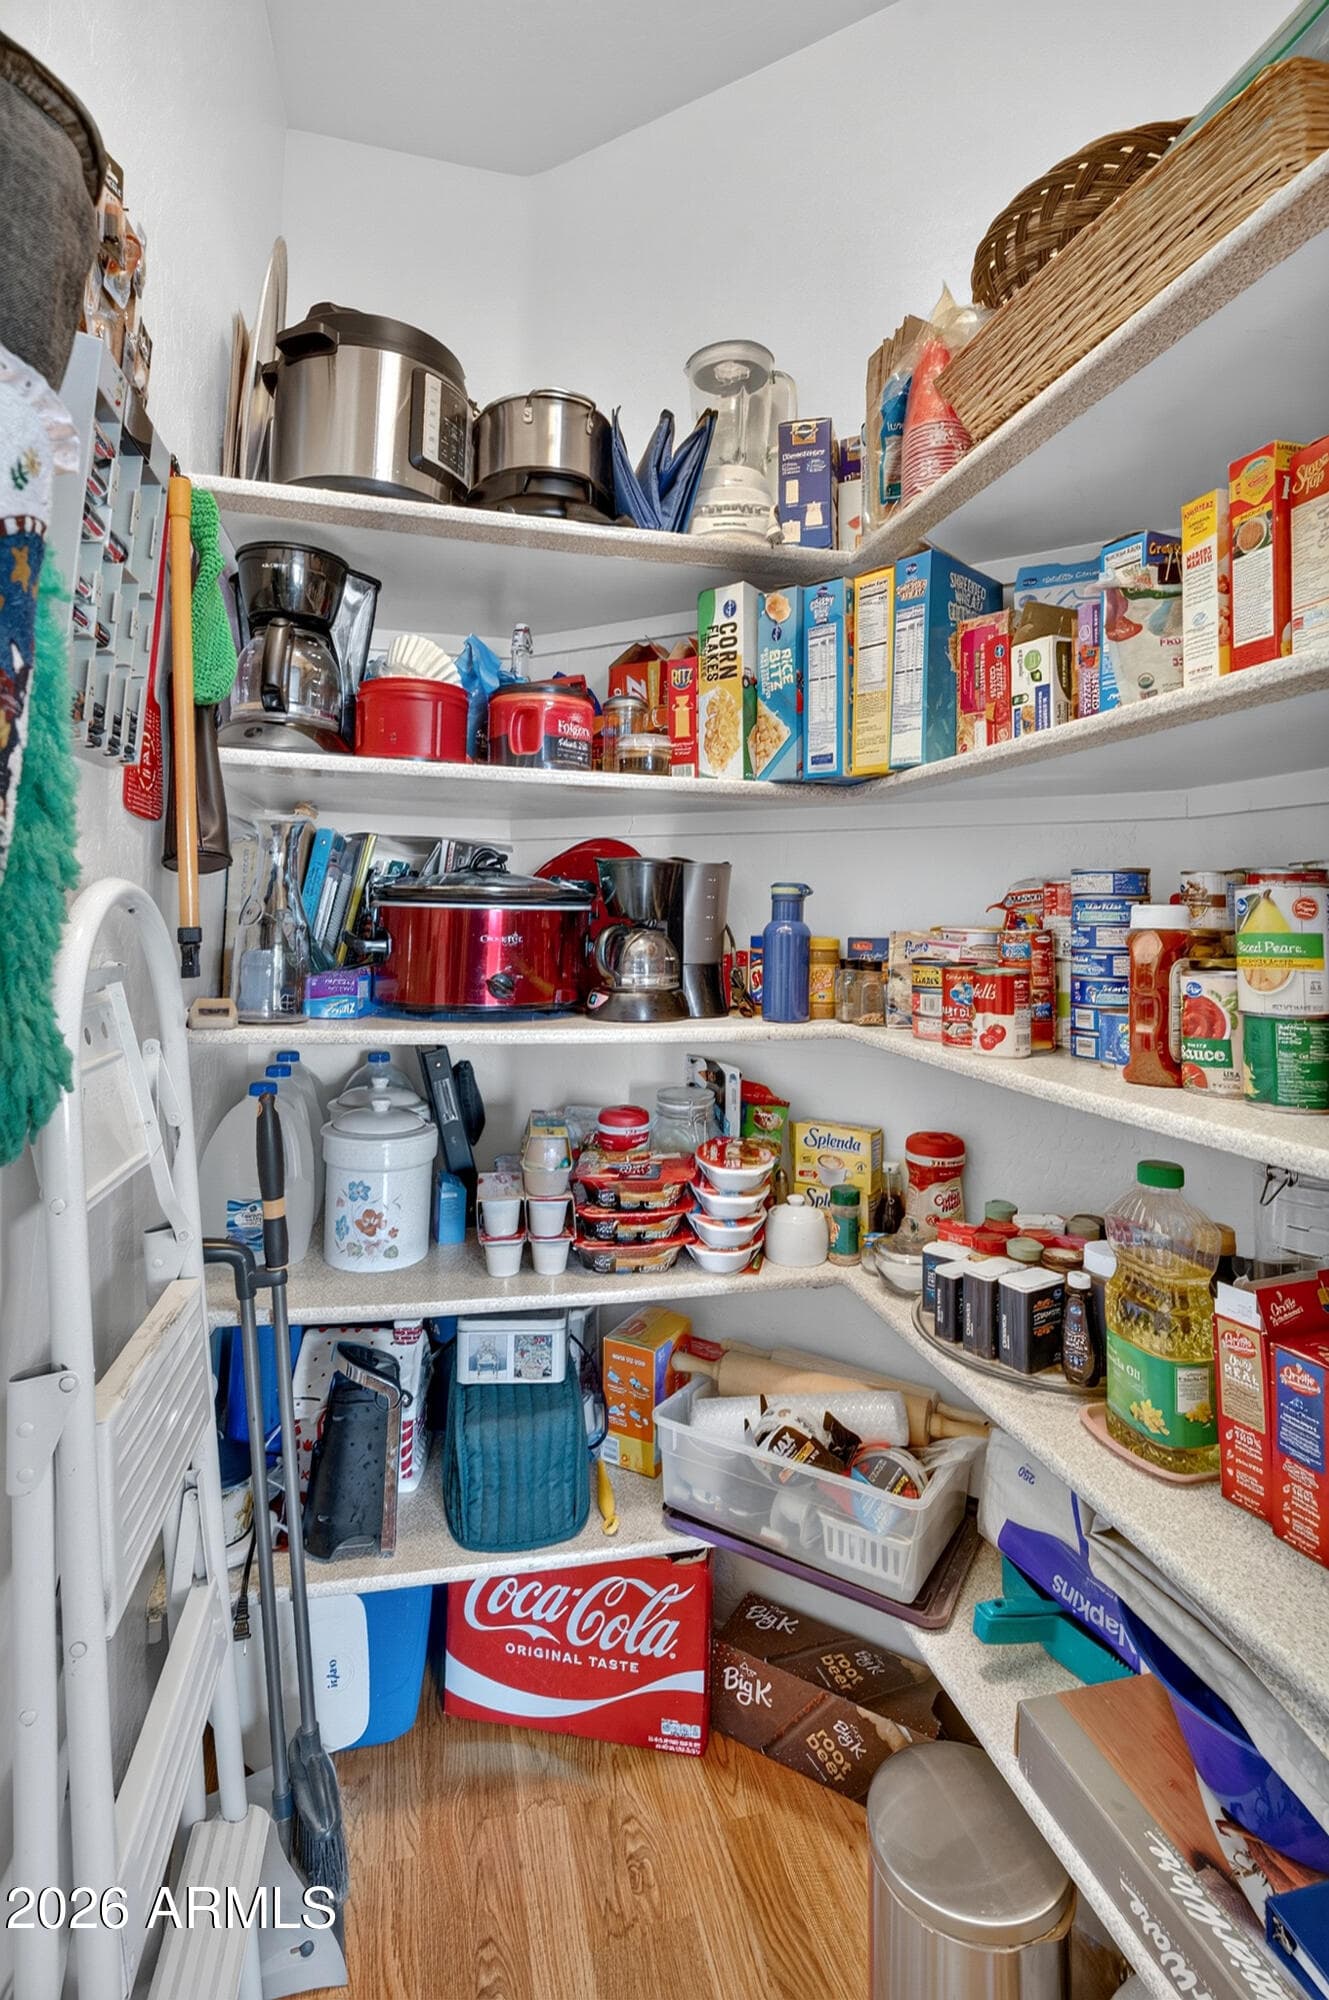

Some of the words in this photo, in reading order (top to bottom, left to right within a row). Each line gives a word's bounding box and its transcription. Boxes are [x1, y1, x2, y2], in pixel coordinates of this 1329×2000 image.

[706, 624, 719, 683] FLAKES
[718, 621, 738, 682] CORN
[768, 648, 784, 693] BITZ
[781, 647, 795, 686] RICE
[671, 667, 694, 686] RITZ
[803, 1127, 862, 1153] Splenda
[1126, 1363, 1141, 1381] Oil
[463, 1575, 696, 1660] Coca-Cola
[504, 1642, 583, 1667] ORIGINAL
[588, 1655, 640, 1675] TASTE
[820, 1653, 853, 1691] beer
[833, 1652, 865, 1685] root
[805, 1732, 846, 1782] beer
[817, 1728, 852, 1775] root
